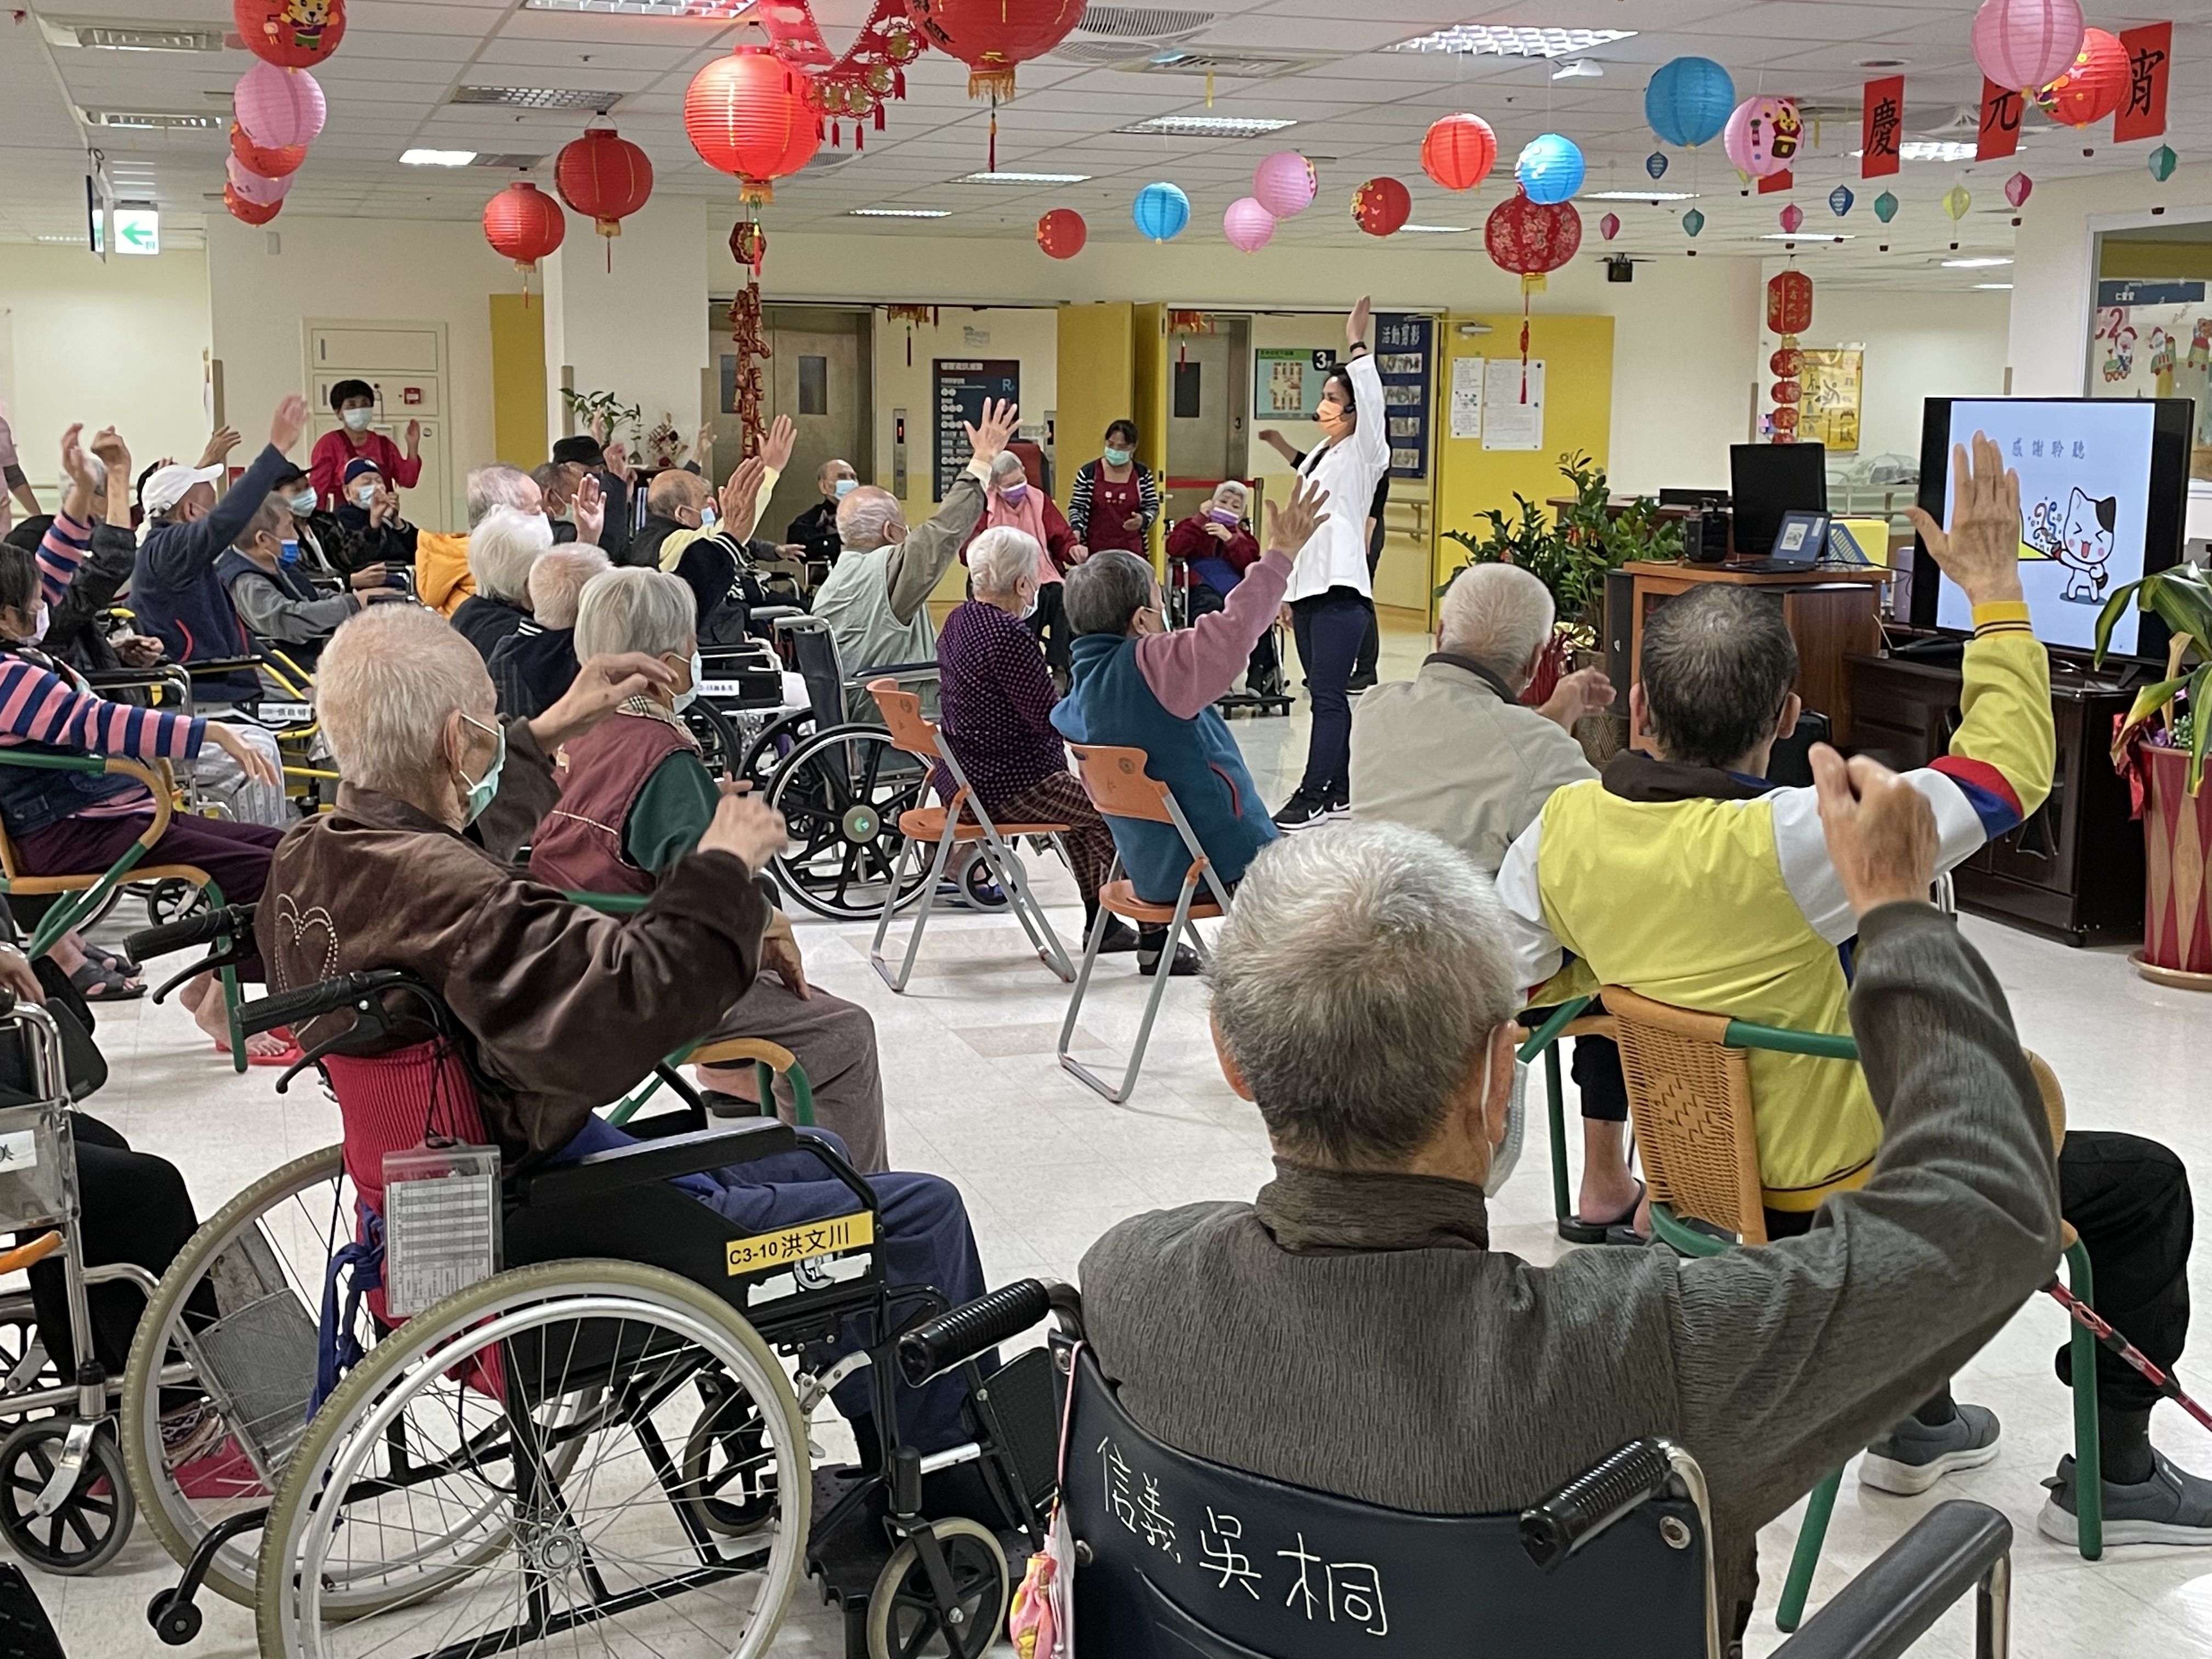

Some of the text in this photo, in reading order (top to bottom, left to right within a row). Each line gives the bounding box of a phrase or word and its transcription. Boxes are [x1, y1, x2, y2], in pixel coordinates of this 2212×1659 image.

[2125, 48, 2165, 117] 宵
[1864, 97, 1900, 157] 慶
[1983, 84, 2019, 133] 元
[1234, 417, 1242, 430] 3
[2012, 437, 2085, 459] 感謝聆聽
[729, 1222, 849, 1265] C3-10 洪文川
